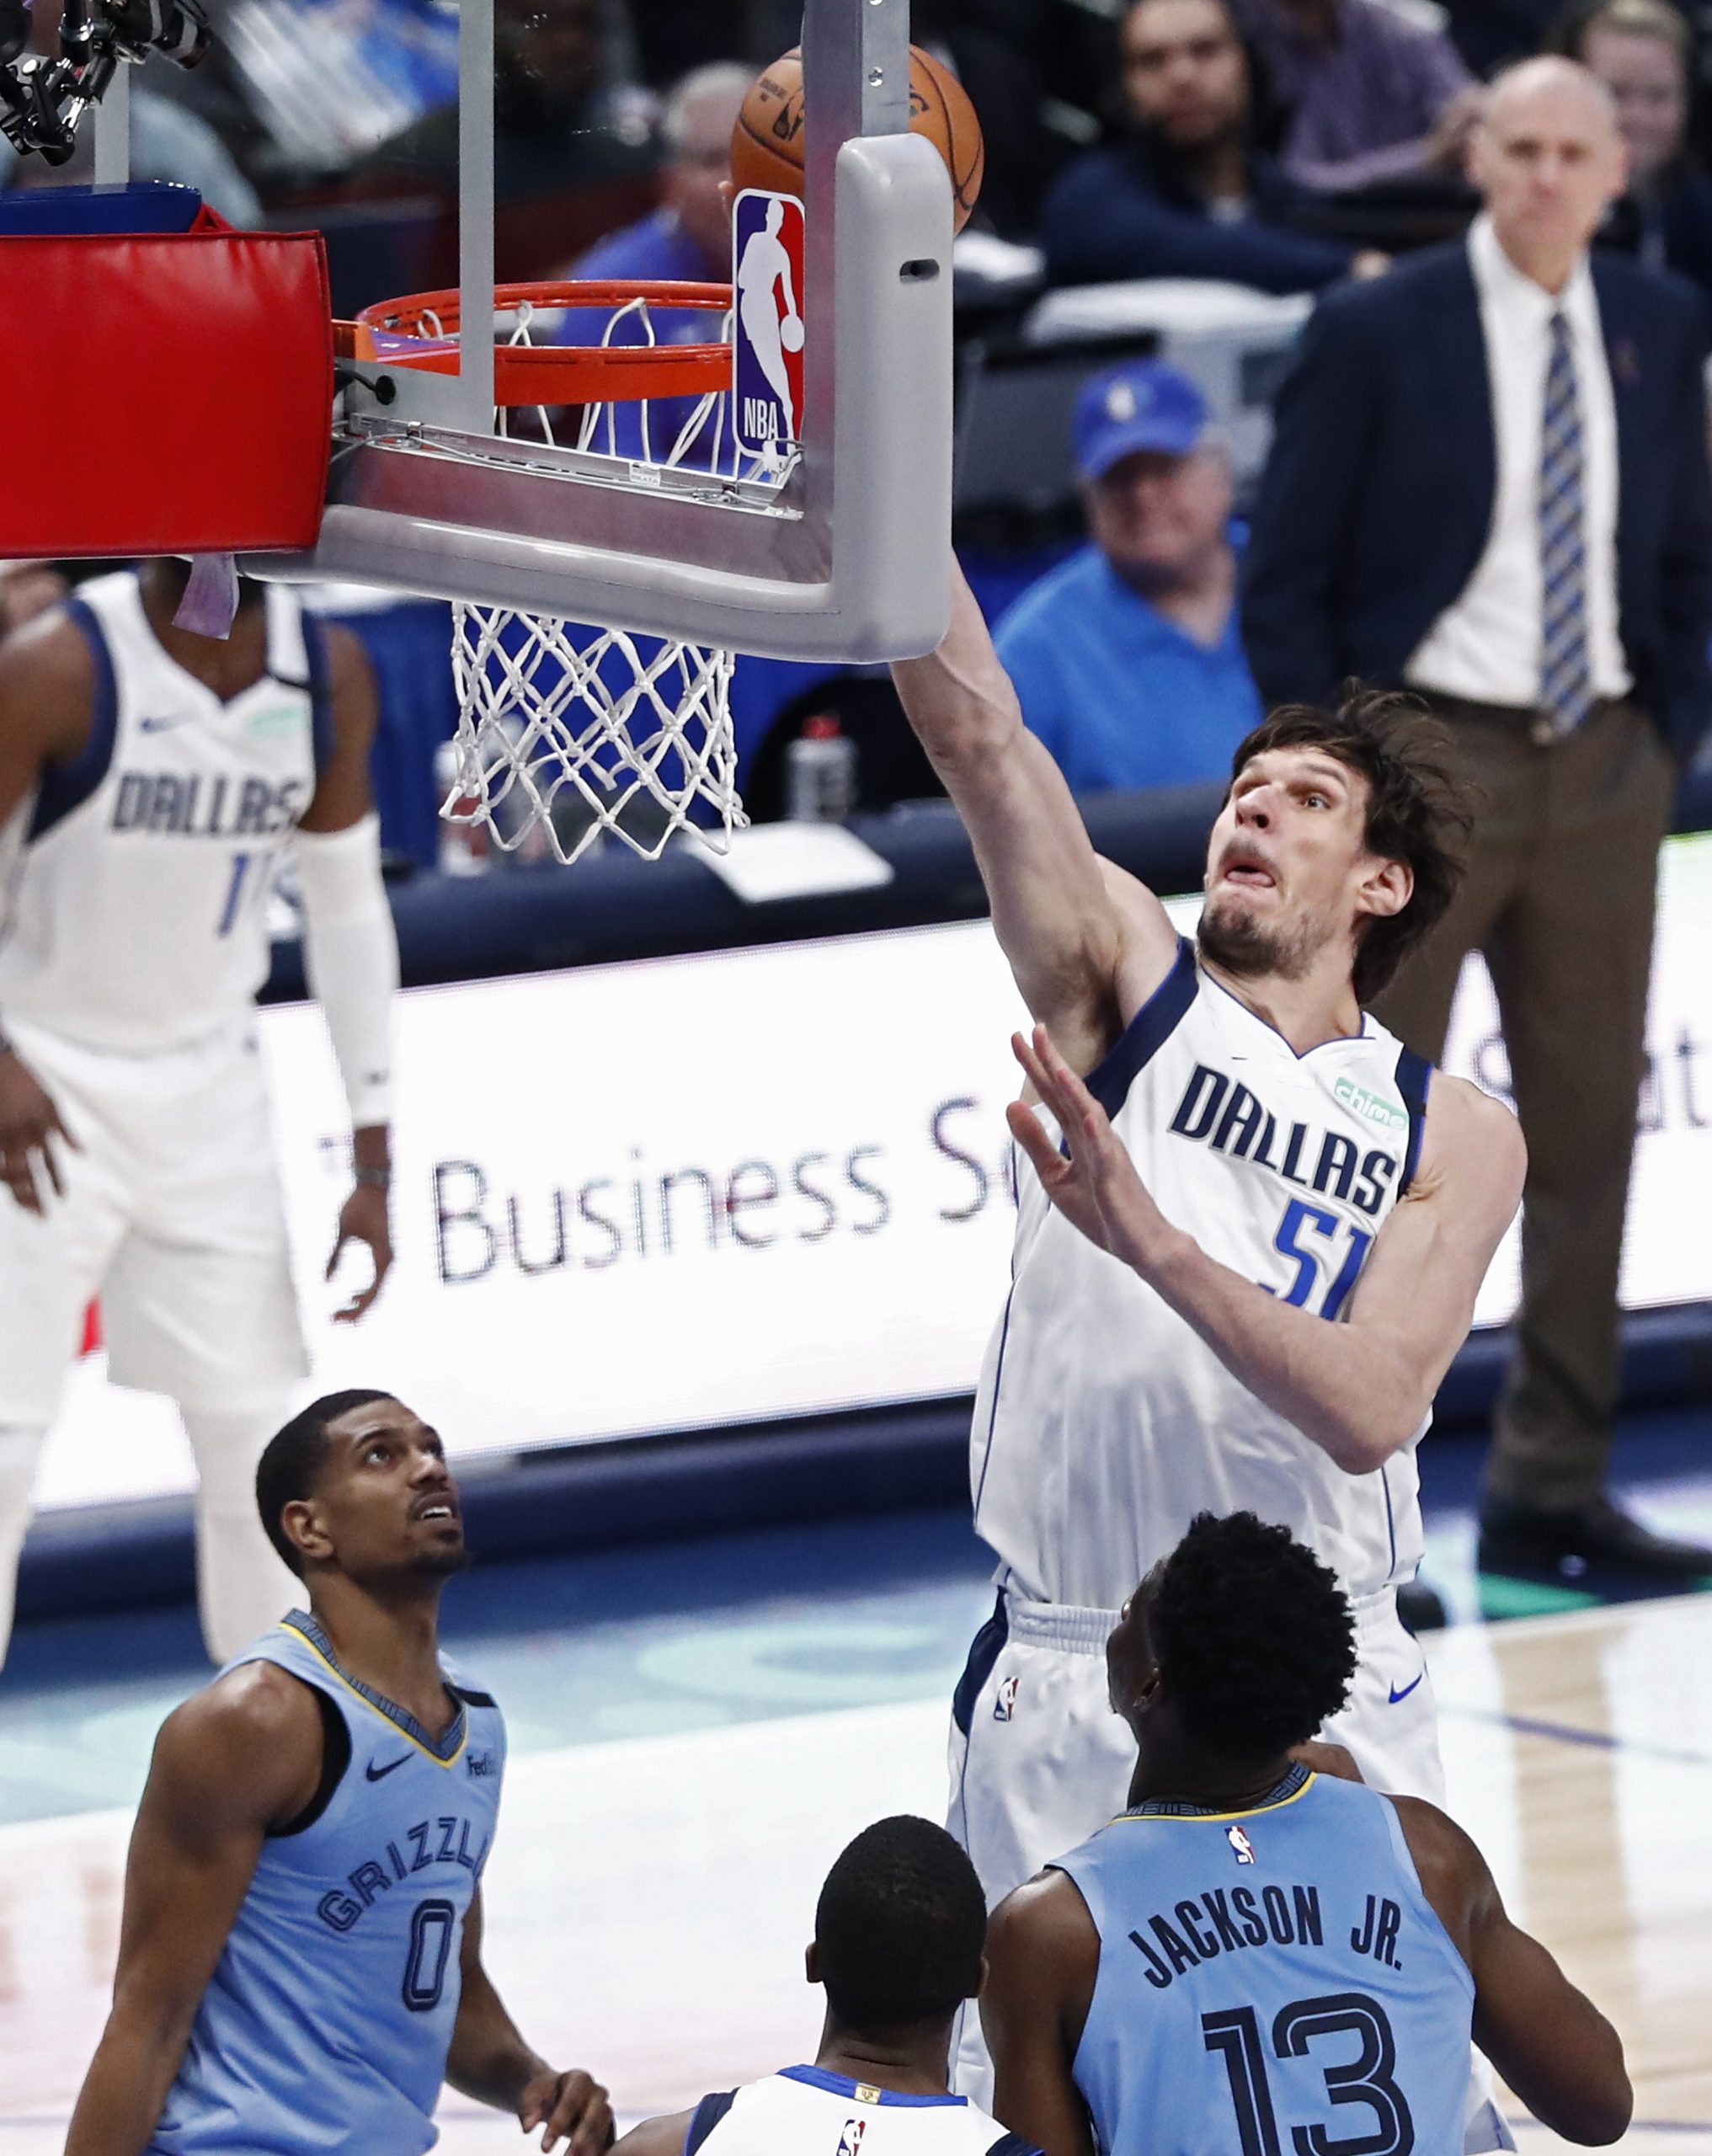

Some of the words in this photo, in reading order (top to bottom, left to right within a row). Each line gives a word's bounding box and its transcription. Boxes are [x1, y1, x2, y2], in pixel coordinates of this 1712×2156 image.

[744, 396, 779, 440] NBA
[110, 768, 301, 834] DALLAS
[1167, 1060, 1396, 1219] DALLAS
[1335, 1085, 1407, 1130] chime
[431, 1142, 889, 1287] Business
[930, 1094, 1016, 1222] S
[1258, 1194, 1376, 1323] 51
[402, 1898, 456, 2012] 0
[1128, 1885, 1324, 1988] JACKSON
[1351, 1894, 1402, 1972] JR.
[1201, 1992, 1415, 2156] 13
